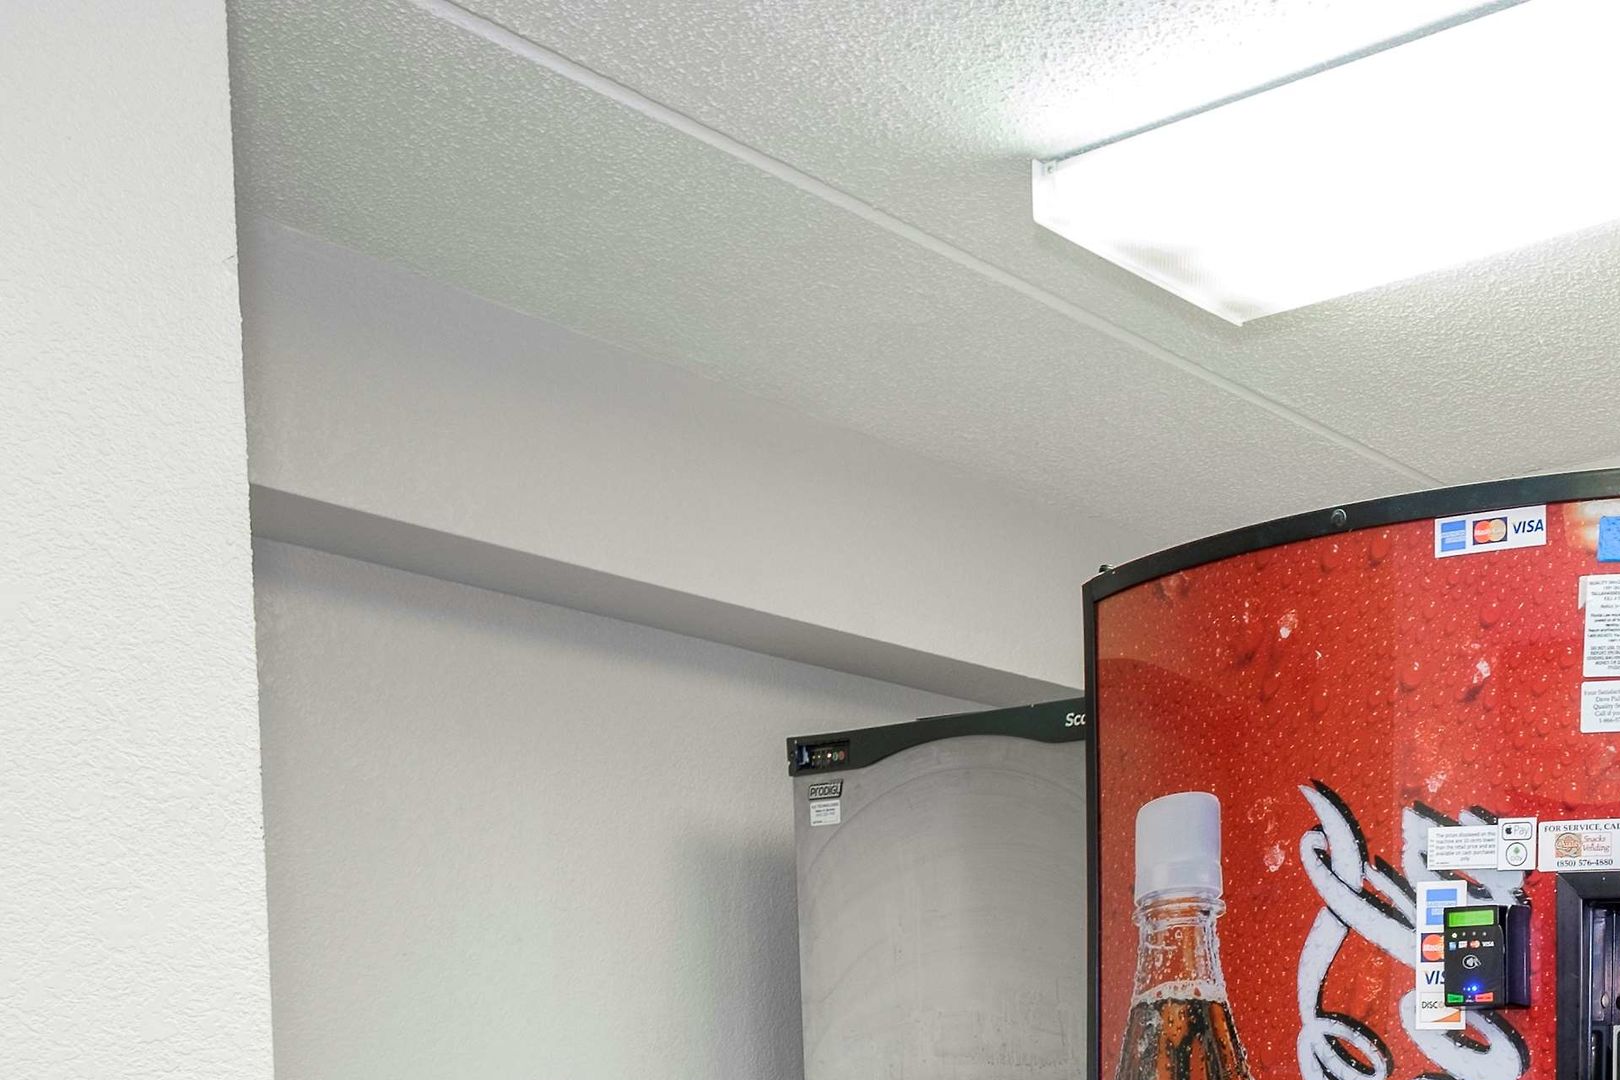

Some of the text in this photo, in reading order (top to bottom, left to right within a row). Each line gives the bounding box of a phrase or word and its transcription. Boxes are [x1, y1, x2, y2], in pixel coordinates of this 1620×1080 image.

[1513, 519, 1544, 534] VISA
[1513, 826, 1529, 836] Pay
[1544, 825, 1561, 833] FOR
[1556, 860, 1576, 868] (850)
[1424, 970, 1445, 985] VIS
